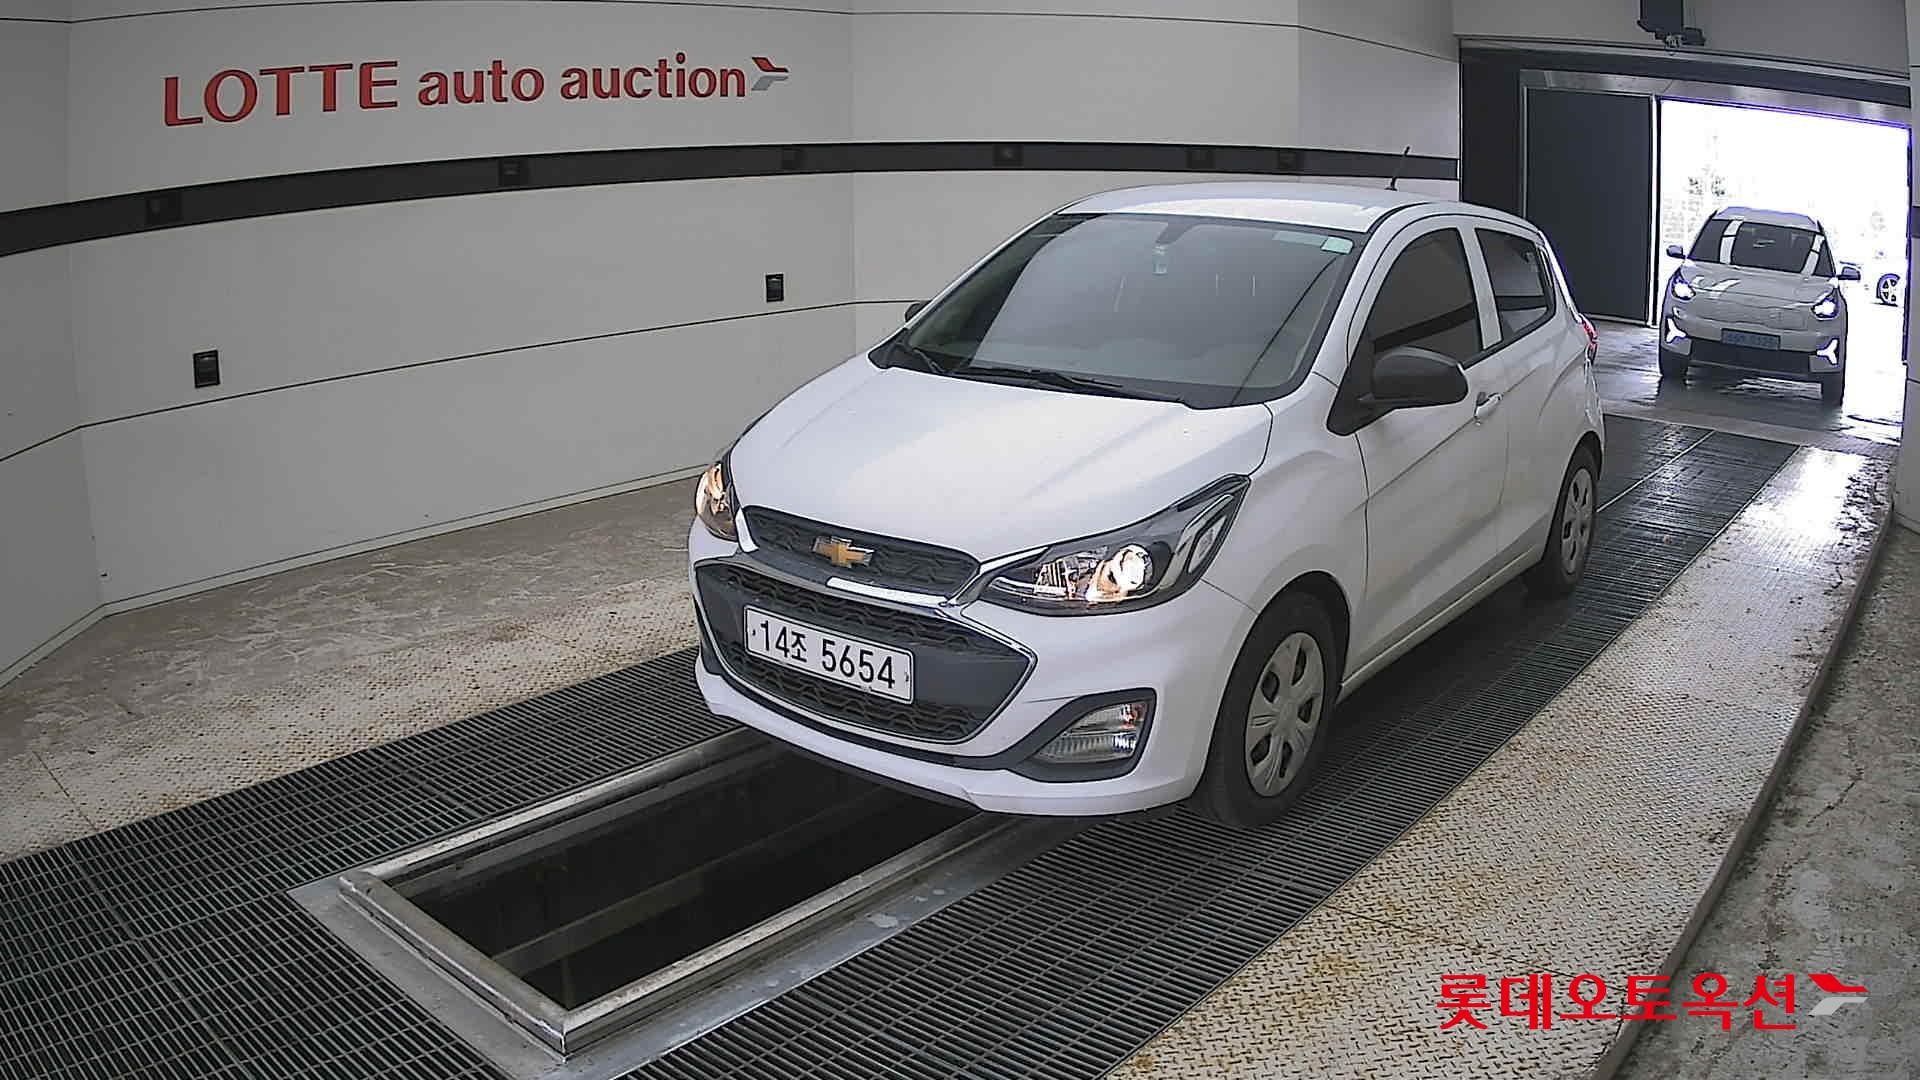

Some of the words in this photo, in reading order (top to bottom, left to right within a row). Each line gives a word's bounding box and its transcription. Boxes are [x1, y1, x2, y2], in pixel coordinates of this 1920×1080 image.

[164, 60, 399, 127] LOTTE
[417, 59, 546, 106] auto
[560, 52, 747, 101] auction
[760, 620, 807, 662] 14조
[822, 638, 895, 689] 5654
